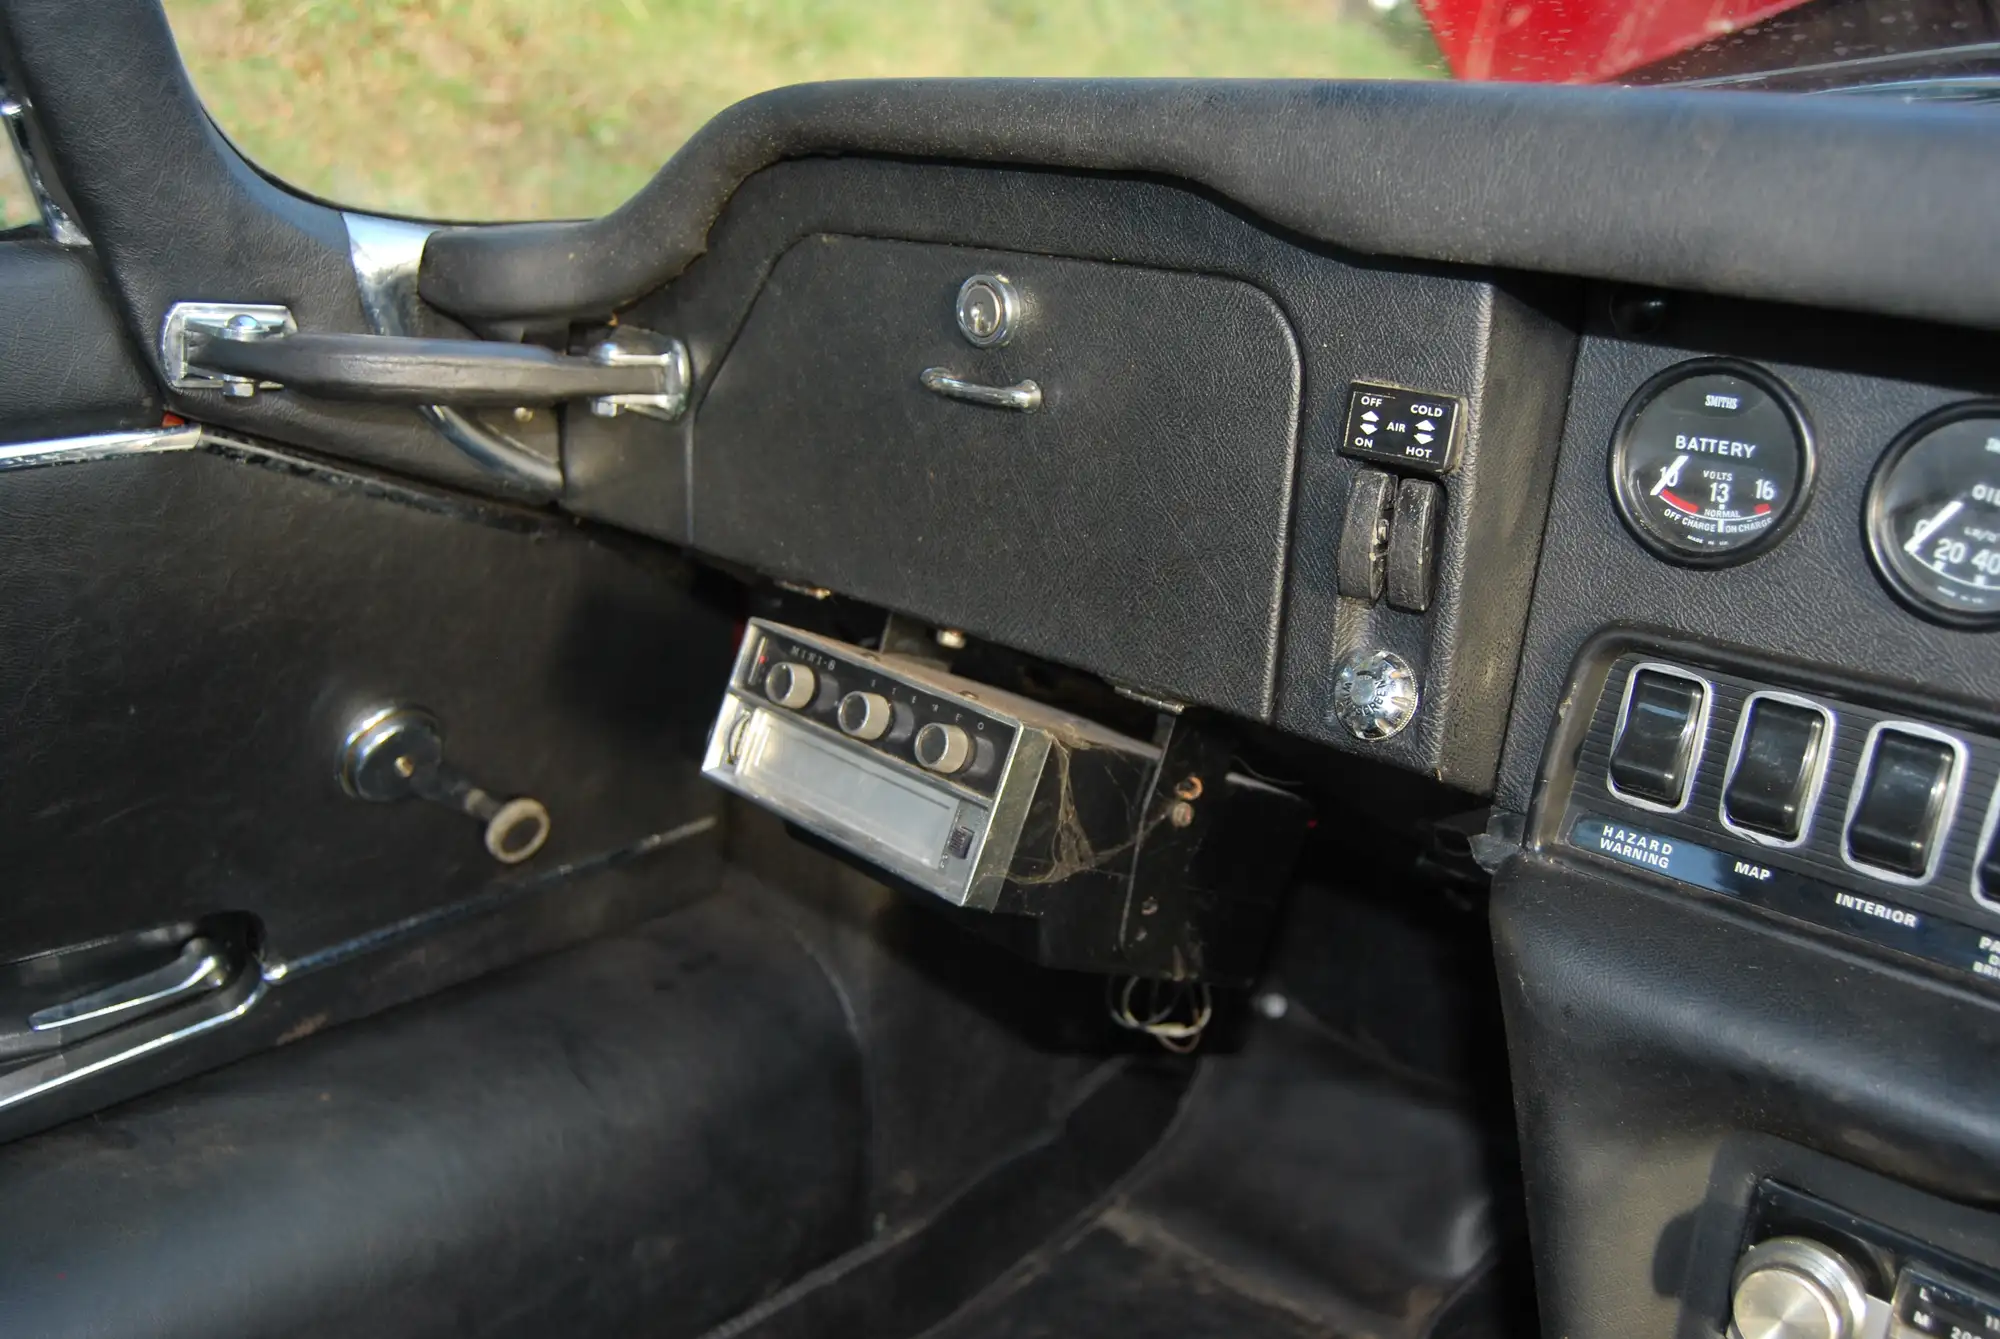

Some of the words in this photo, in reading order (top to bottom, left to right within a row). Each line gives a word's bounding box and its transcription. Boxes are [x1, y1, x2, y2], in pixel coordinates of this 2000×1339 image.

[1360, 395, 1383, 408] OFF
[1410, 404, 1443, 418] COLD
[1705, 394, 1738, 410] SMITHS
[1386, 421, 1406, 433] AIR
[1354, 437, 1374, 449] ON
[1405, 446, 1433, 459] HOT
[1675, 435, 1756, 459] BATTERY
[1703, 470, 1733, 481] VOLTS
[1710, 483, 1730, 503] 13
[1755, 479, 1775, 500] 16
[1664, 508, 1681, 521] OFF
[1682, 517, 1716, 532] CHARGE
[1704, 508, 1741, 518] NORMAL
[1725, 525, 1738, 533] ON
[1738, 517, 1773, 532] CHARGE
[1933, 537, 1967, 565] 20
[1970, 548, 2000, 576] 40
[1602, 824, 1674, 856] HAZARD
[1600, 837, 1670, 869] WARNING
[1734, 861, 1771, 881] MAP
[1835, 892, 1917, 928] INTERIOR
[1973, 961, 2000, 980] BRI
